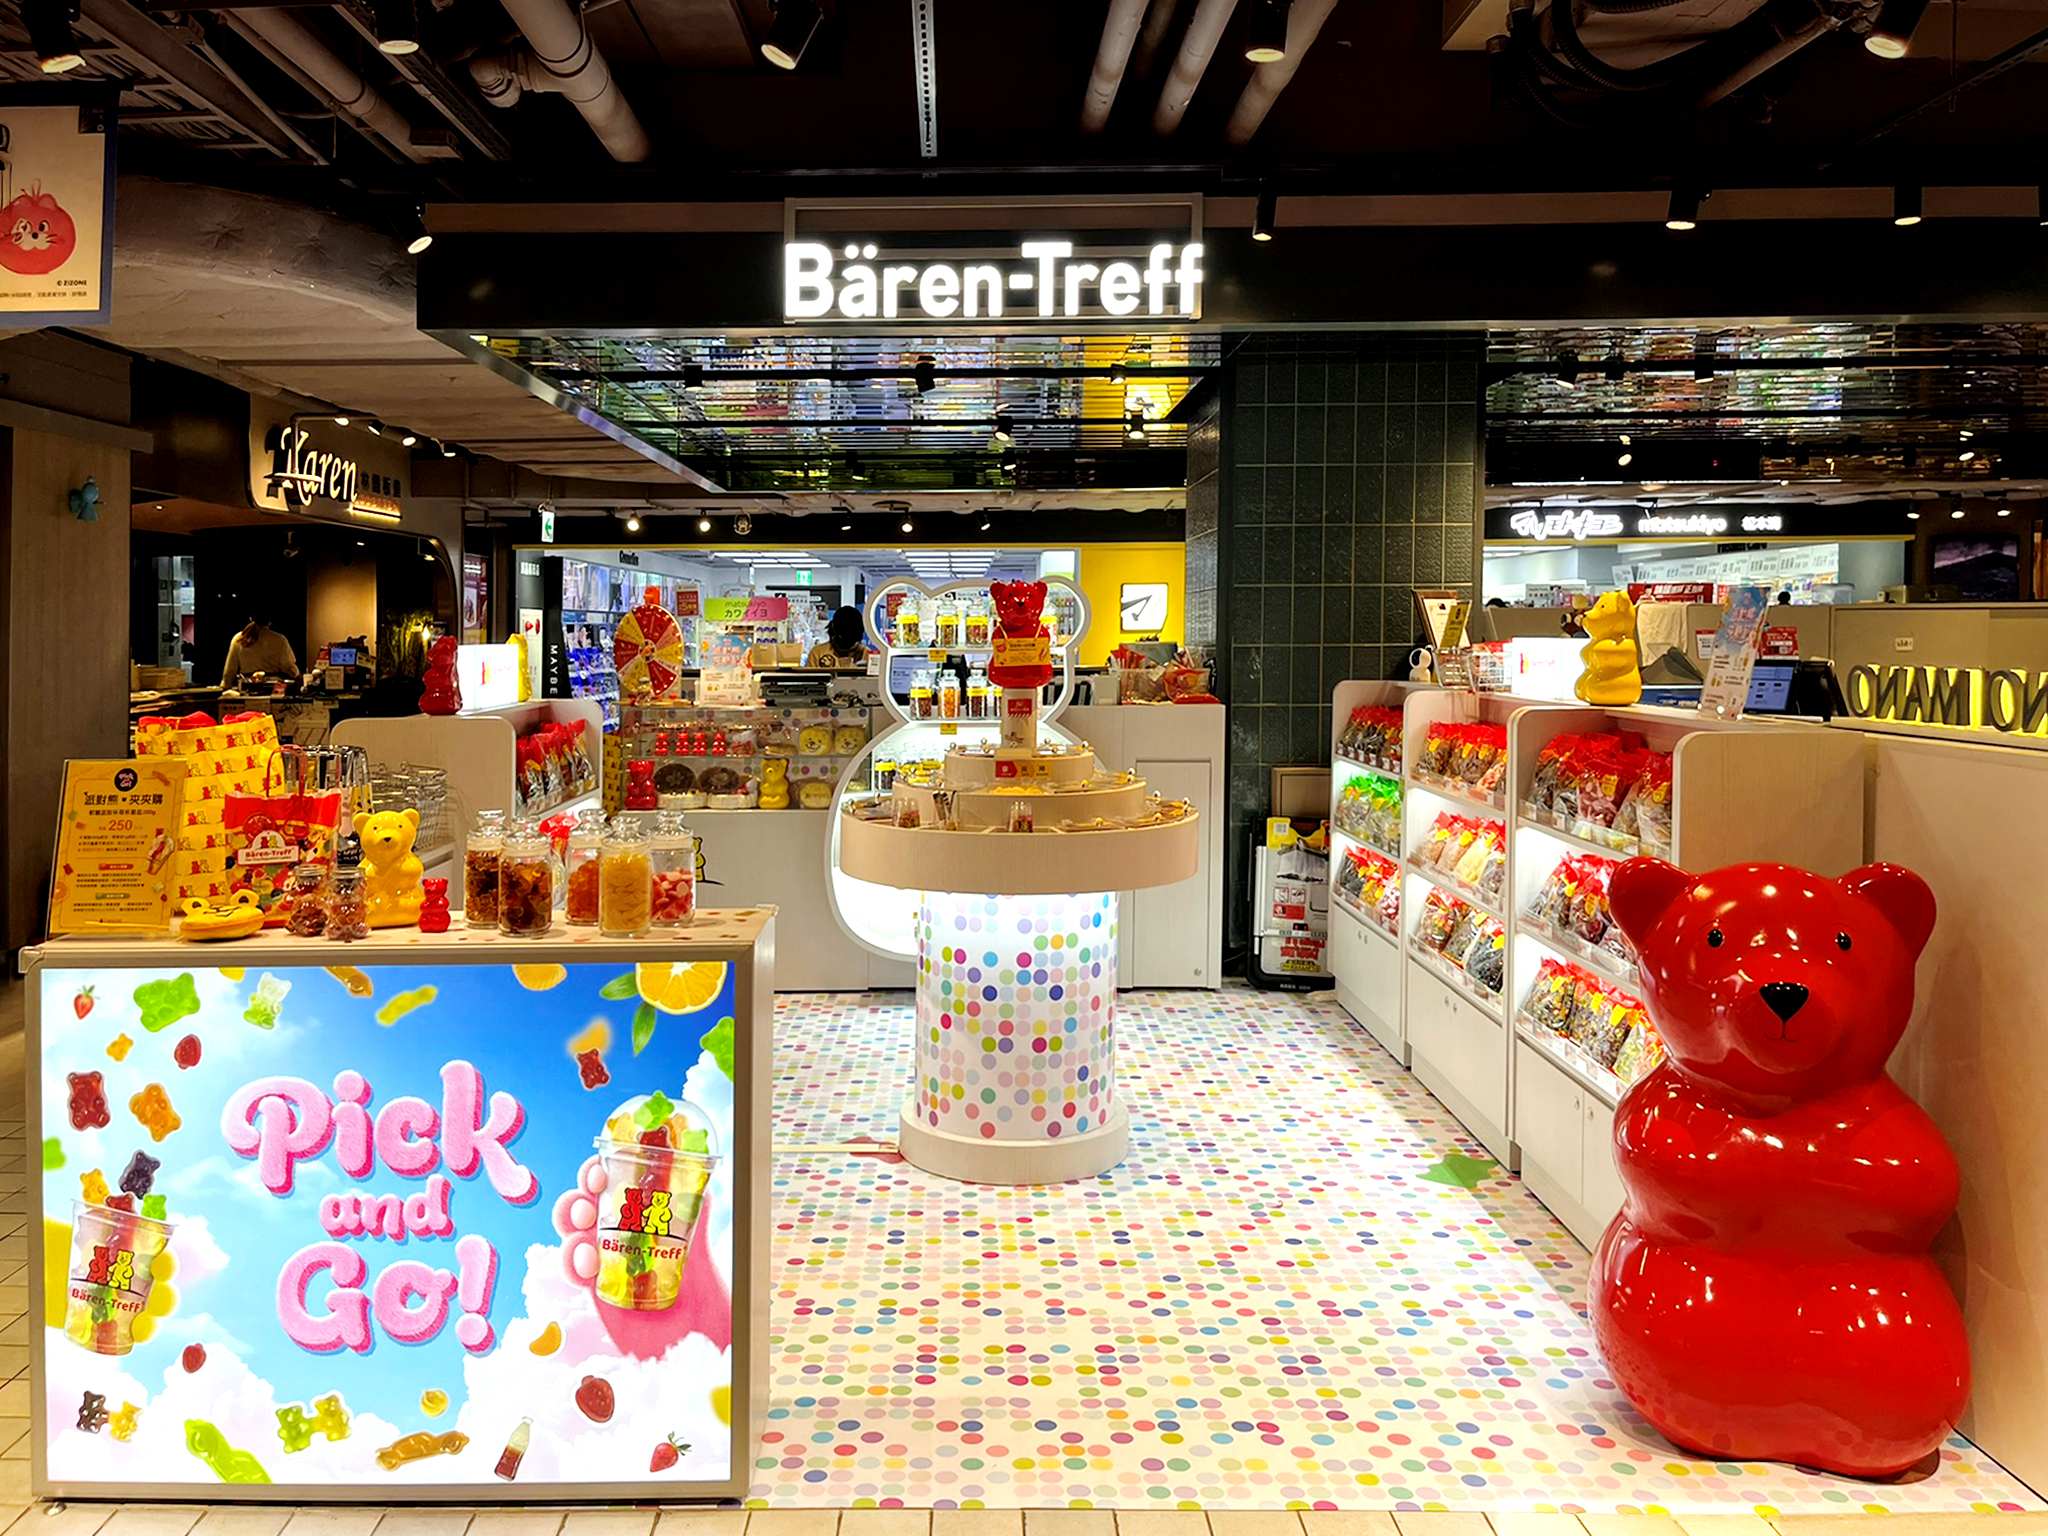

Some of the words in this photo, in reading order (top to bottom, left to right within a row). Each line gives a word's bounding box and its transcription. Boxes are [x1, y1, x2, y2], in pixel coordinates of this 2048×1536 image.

[784, 241, 1205, 318] Bären-Treff
[279, 426, 358, 507] Karen
[108, 819, 134, 832] 250
[220, 1059, 539, 1203] Pick
[319, 1173, 455, 1242] and
[602, 1239, 683, 1260] Bären-Treff
[71, 1288, 142, 1313] Bären-Treff
[276, 1235, 498, 1356] Go!
